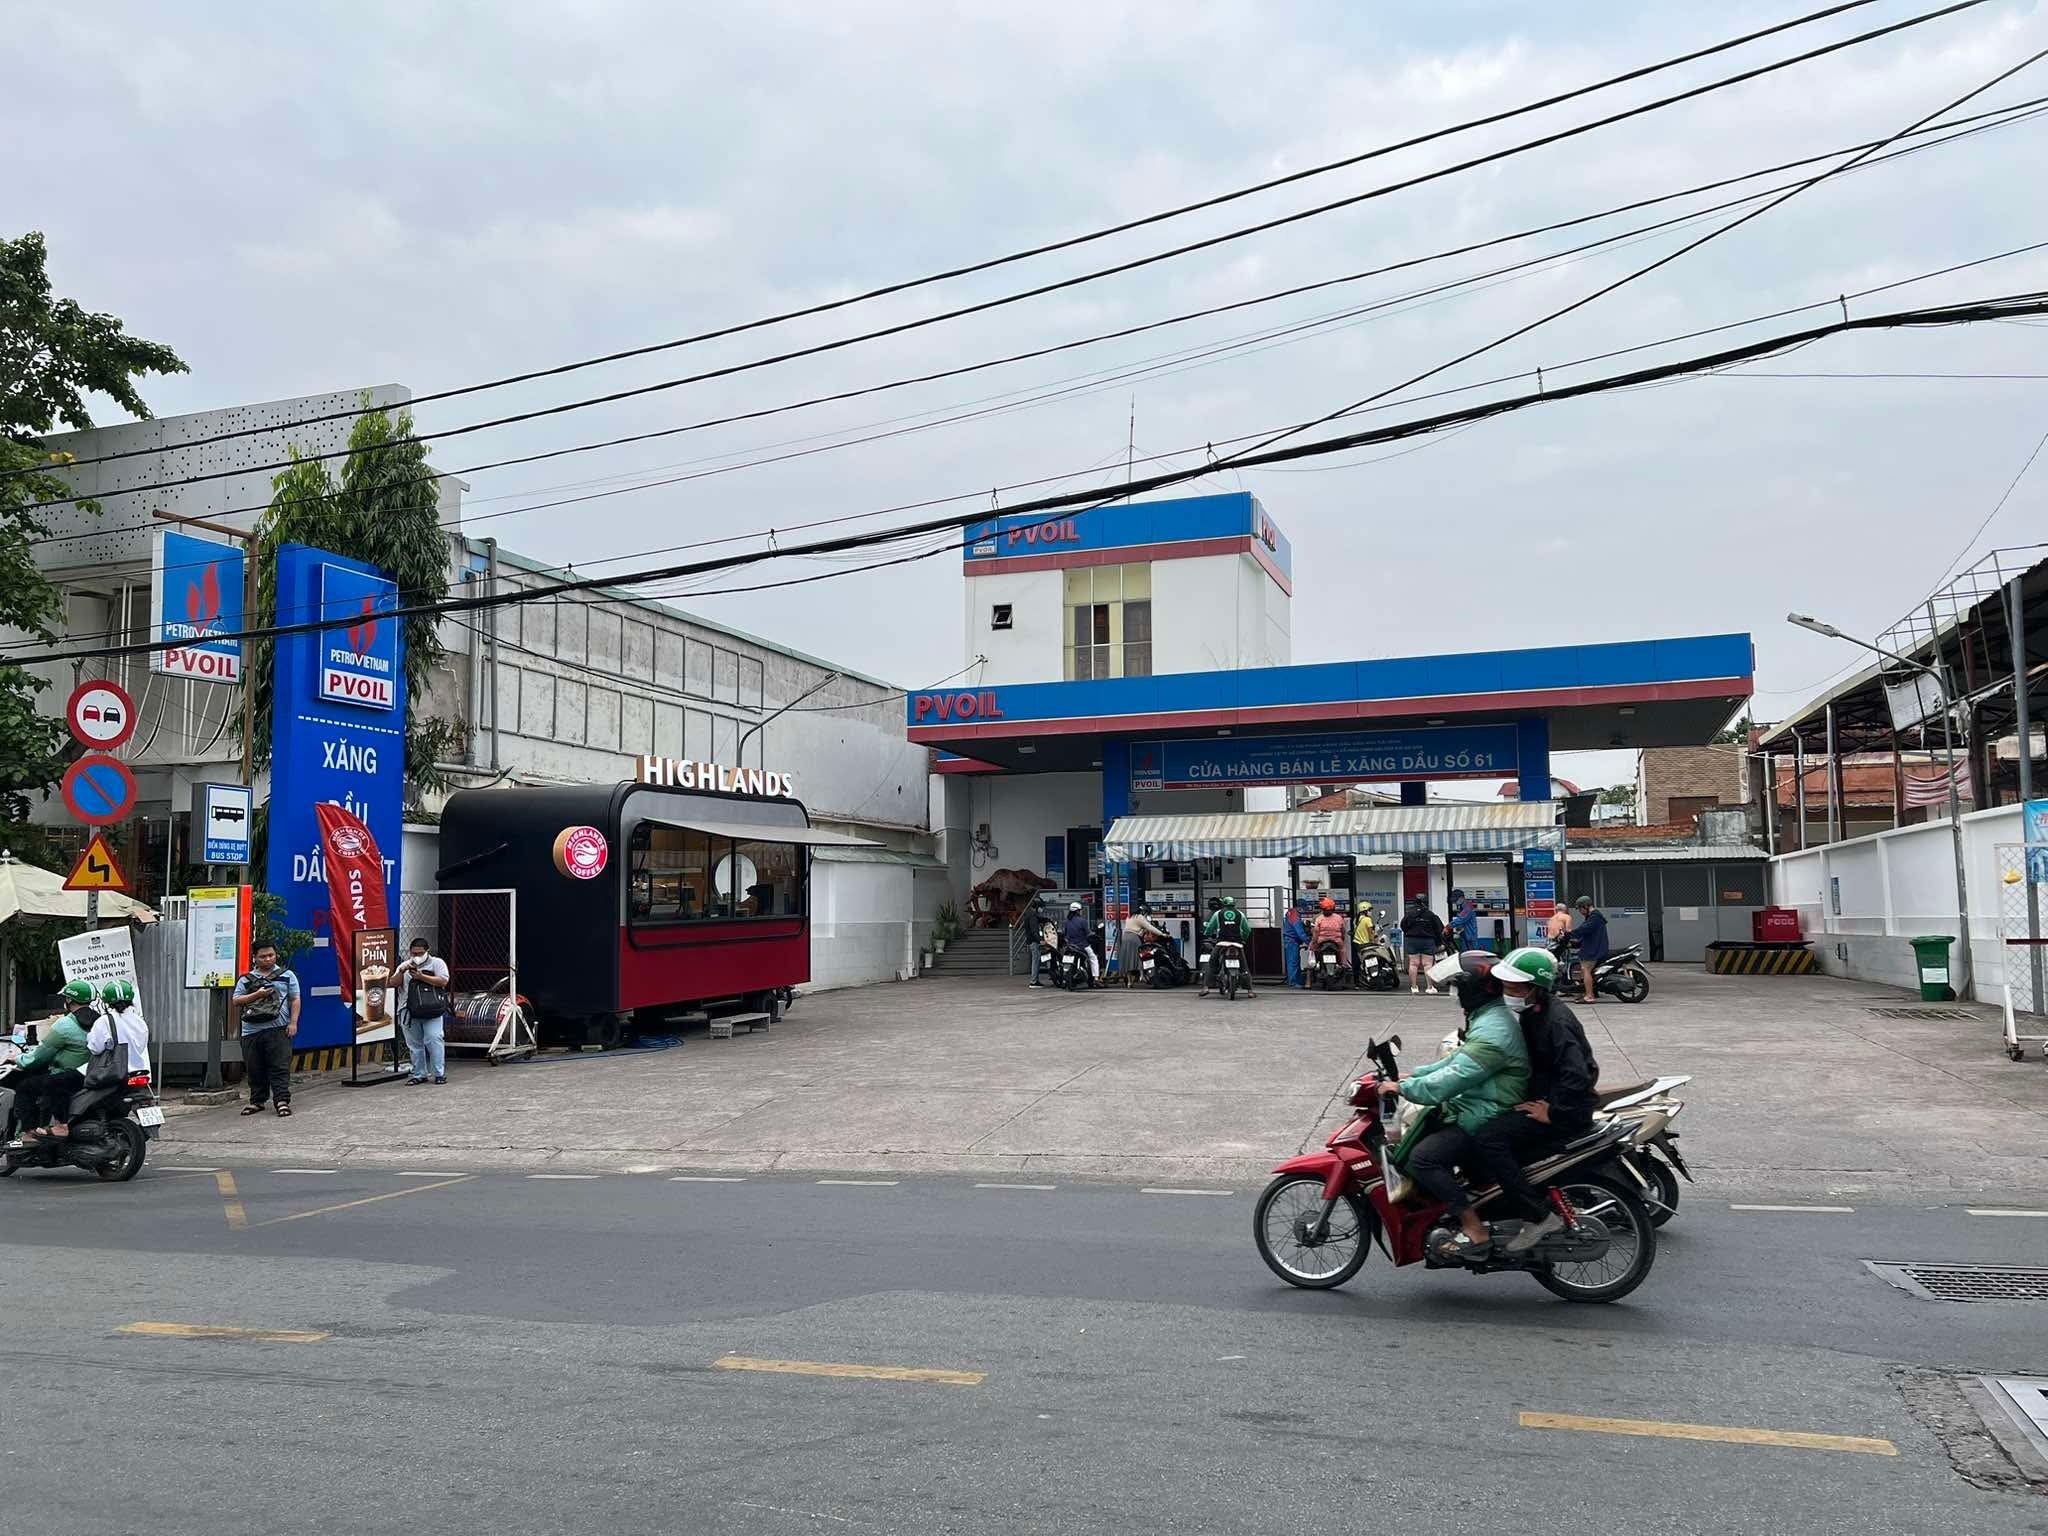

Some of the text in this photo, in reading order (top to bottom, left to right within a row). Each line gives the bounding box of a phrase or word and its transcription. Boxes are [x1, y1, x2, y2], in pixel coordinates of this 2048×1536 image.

[1008, 520, 1080, 545] PVOIL
[165, 649, 237, 678] PVOIL
[331, 649, 389, 672] PETROVIETNAM
[330, 674, 388, 701] PVOIL
[914, 691, 1004, 720] PVOIL
[322, 738, 377, 774] XĂNG
[1188, 760, 1222, 778] CỬA
[1227, 759, 1274, 777] HÀNG
[1280, 758, 1314, 775] BÁN
[1320, 755, 1343, 773] LẺ
[1347, 755, 1396, 772] XĂNG
[1402, 751, 1439, 769] DẦU
[1444, 749, 1470, 768] SỐ
[1474, 753, 1493, 767] 61
[643, 755, 793, 798] HIGHLANDS
[1135, 781, 1159, 789] PVOIL
[567, 829, 605, 850] HIGHLANDS
[211, 851, 244, 861] BUS STOP
[571, 863, 601, 877] COFFEE
[65, 957, 87, 967] Sáng
[101, 971, 114, 979] 17k
